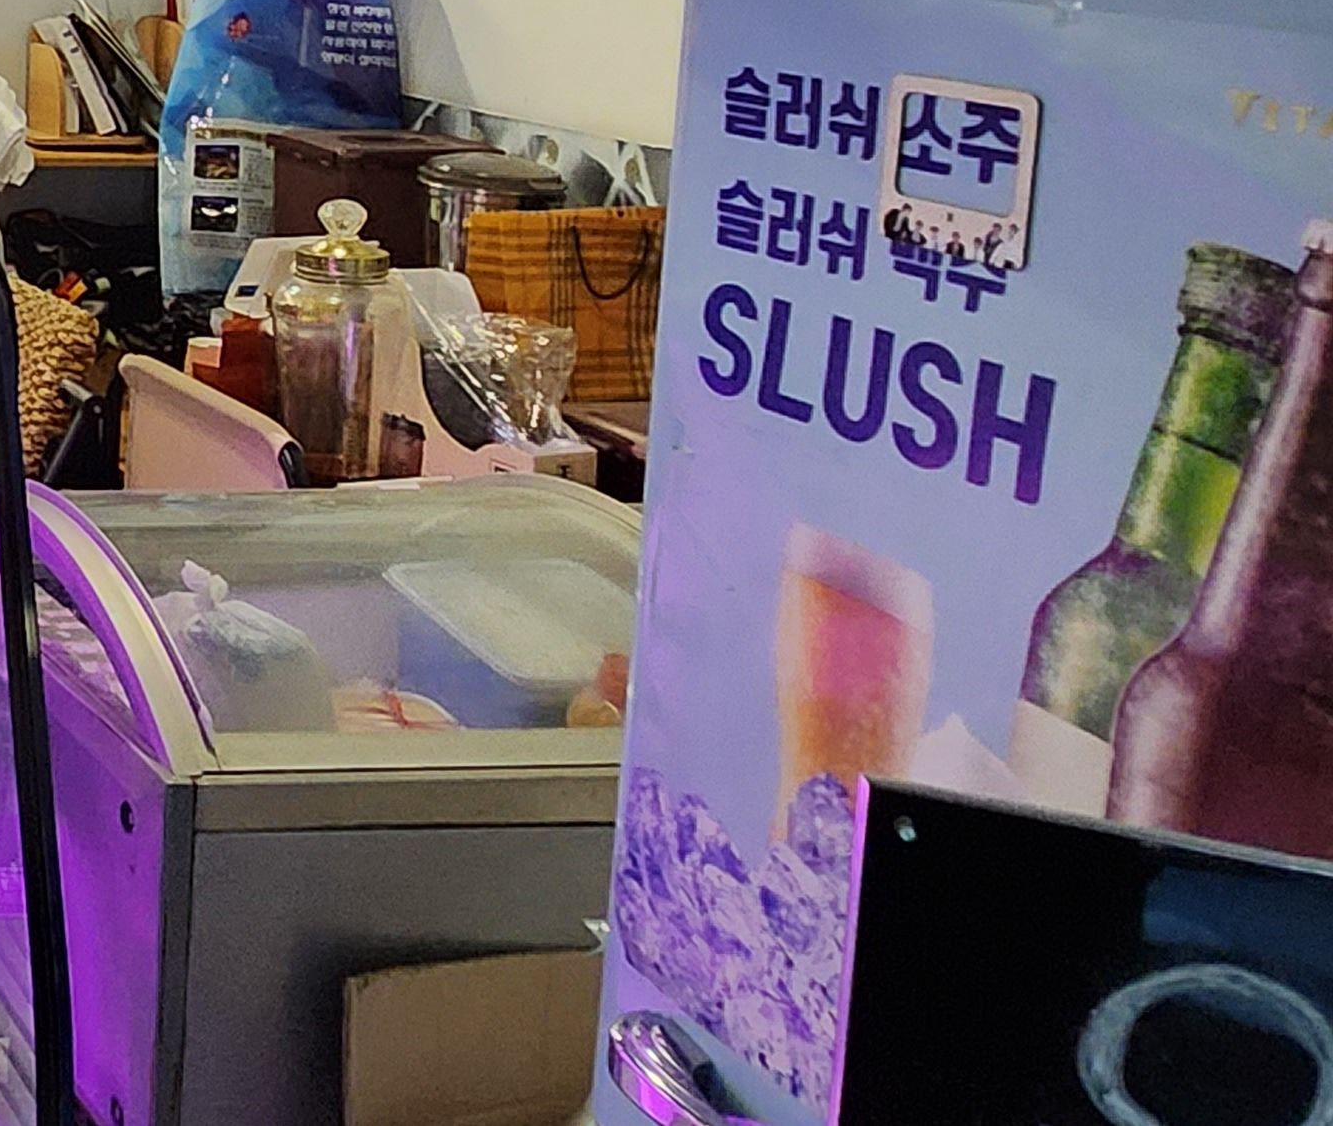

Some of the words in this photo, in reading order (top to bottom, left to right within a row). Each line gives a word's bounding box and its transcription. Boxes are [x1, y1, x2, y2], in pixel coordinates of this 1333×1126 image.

[723, 66, 881, 162] 슬러쉬
[899, 94, 1021, 184] 소주
[716, 178, 871, 281] 슬러쉬
[697, 282, 1057, 505] SLUSH
